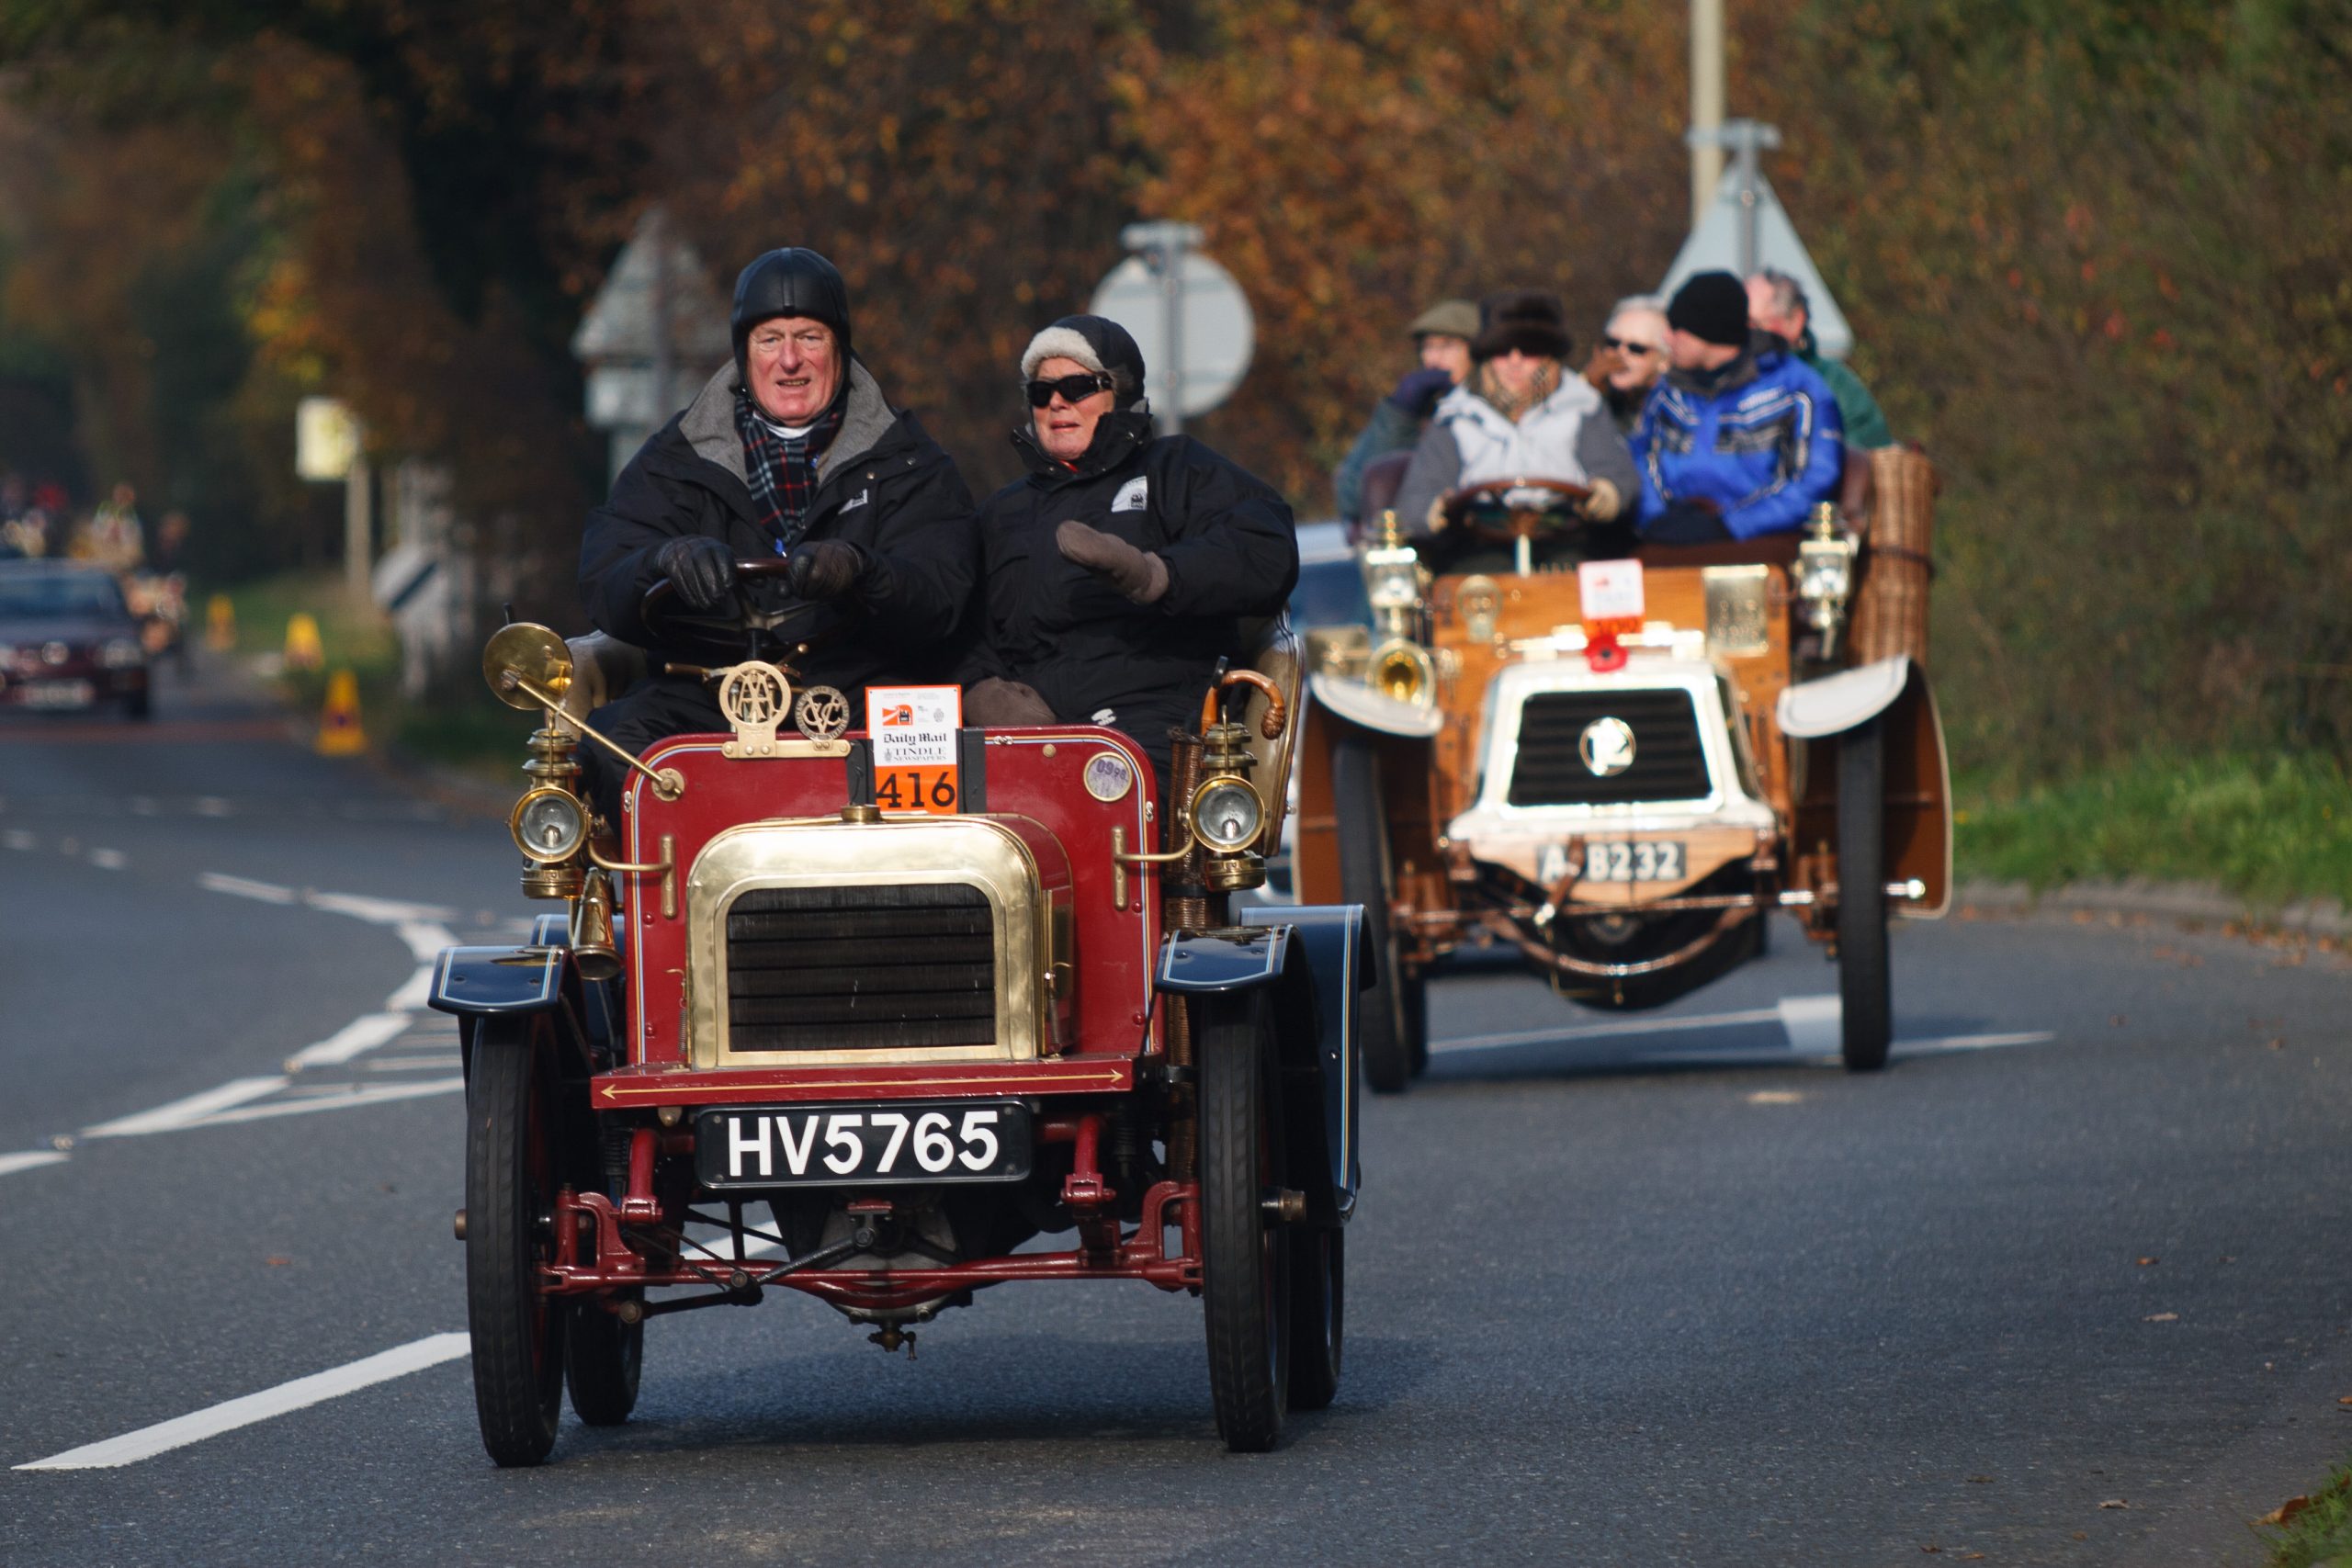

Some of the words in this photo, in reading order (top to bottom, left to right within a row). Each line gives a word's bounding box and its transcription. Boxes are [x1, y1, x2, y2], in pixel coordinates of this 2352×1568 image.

[883, 733, 916, 746] Daily
[919, 732, 947, 742] Mail
[876, 772, 956, 807] 416
[728, 1111, 999, 1177] HV5765
